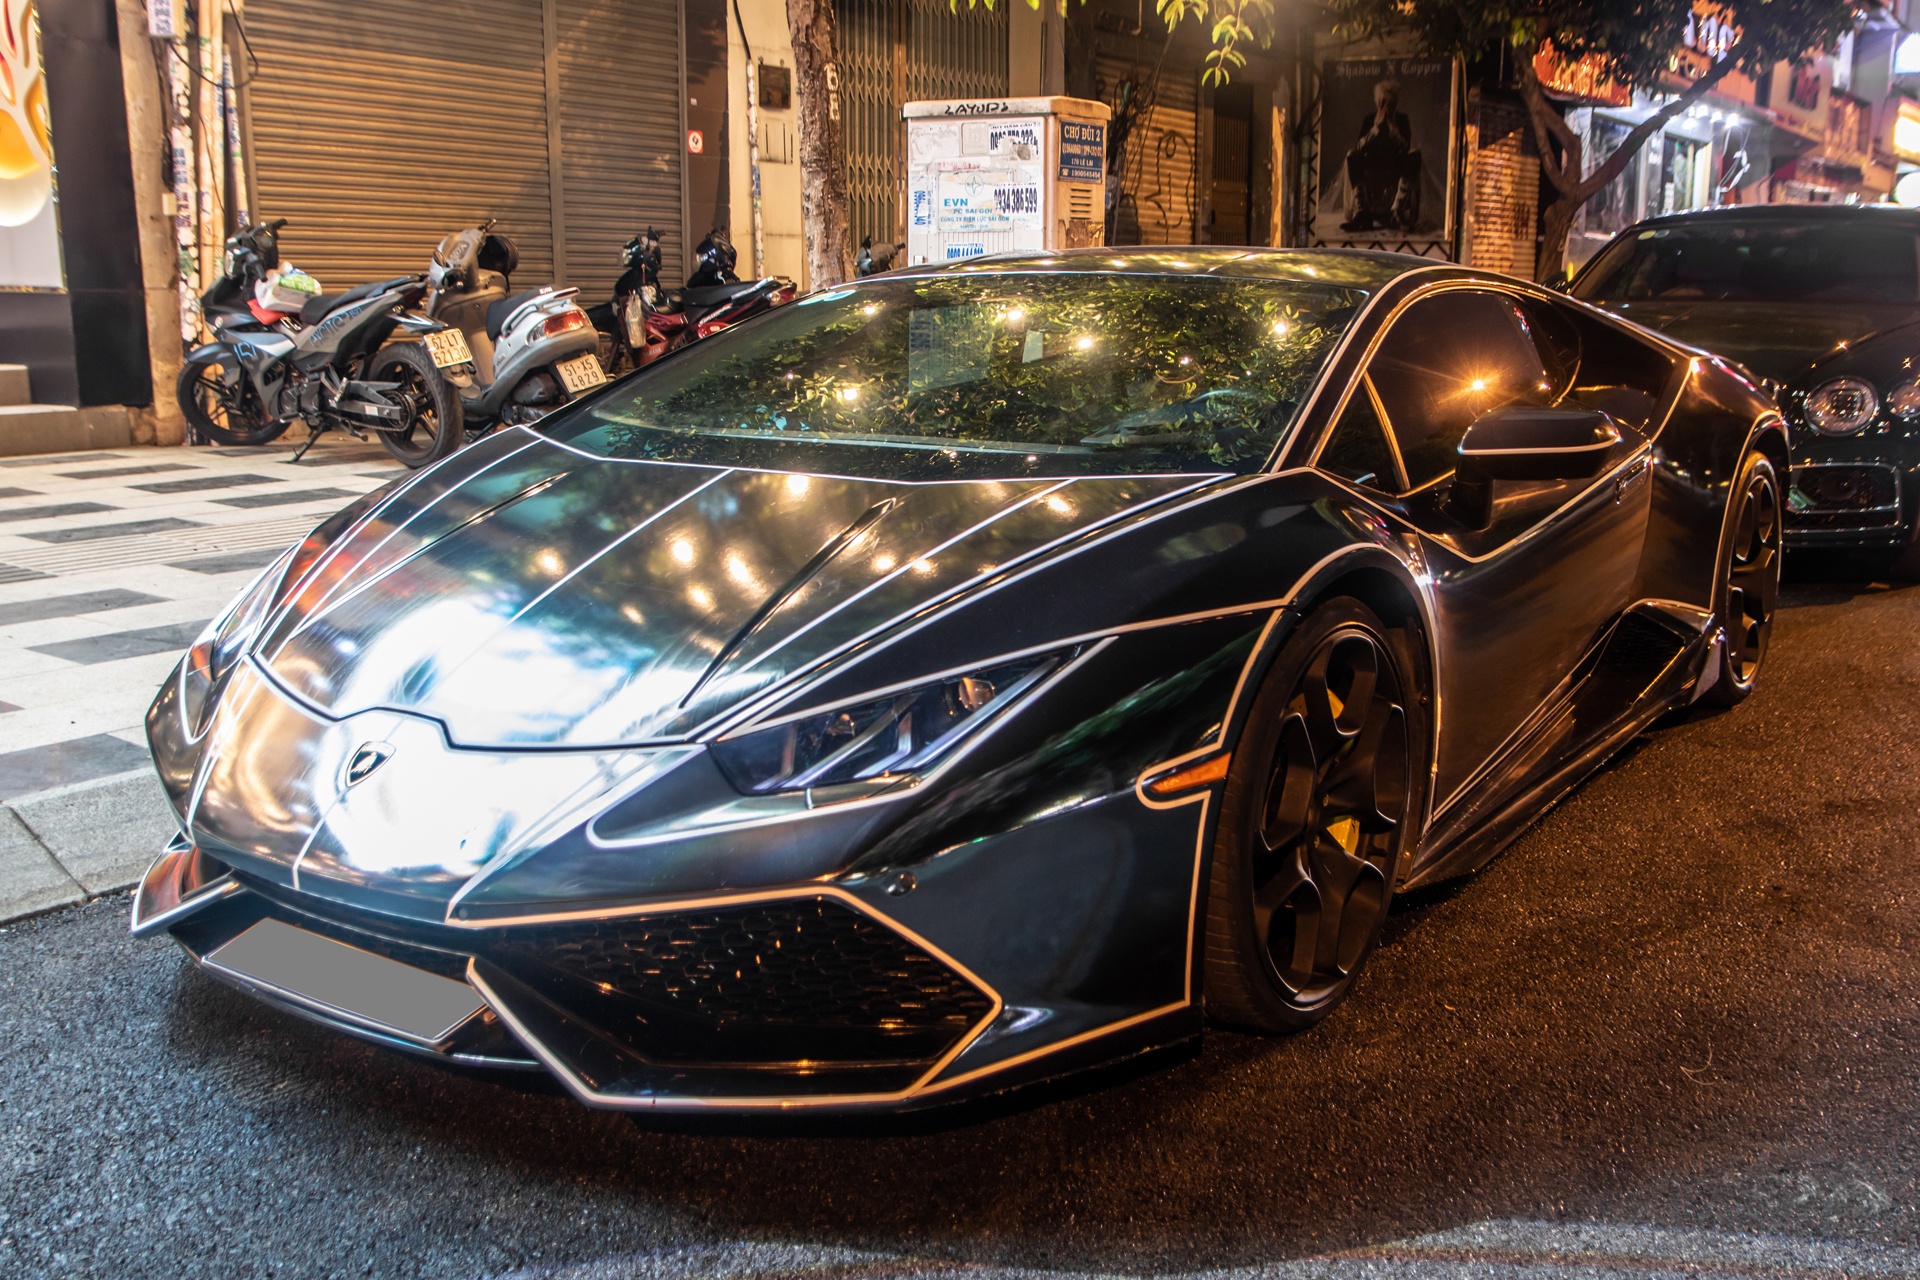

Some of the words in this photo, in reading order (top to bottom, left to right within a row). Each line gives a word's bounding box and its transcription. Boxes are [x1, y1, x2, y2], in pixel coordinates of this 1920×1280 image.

[1401, 60, 1442, 77] Copper
[1064, 124, 1080, 141] CHỢ
[1095, 129, 1101, 142] 2
[943, 198, 969, 207] EVN
[571, 371, 600, 389] 4829
